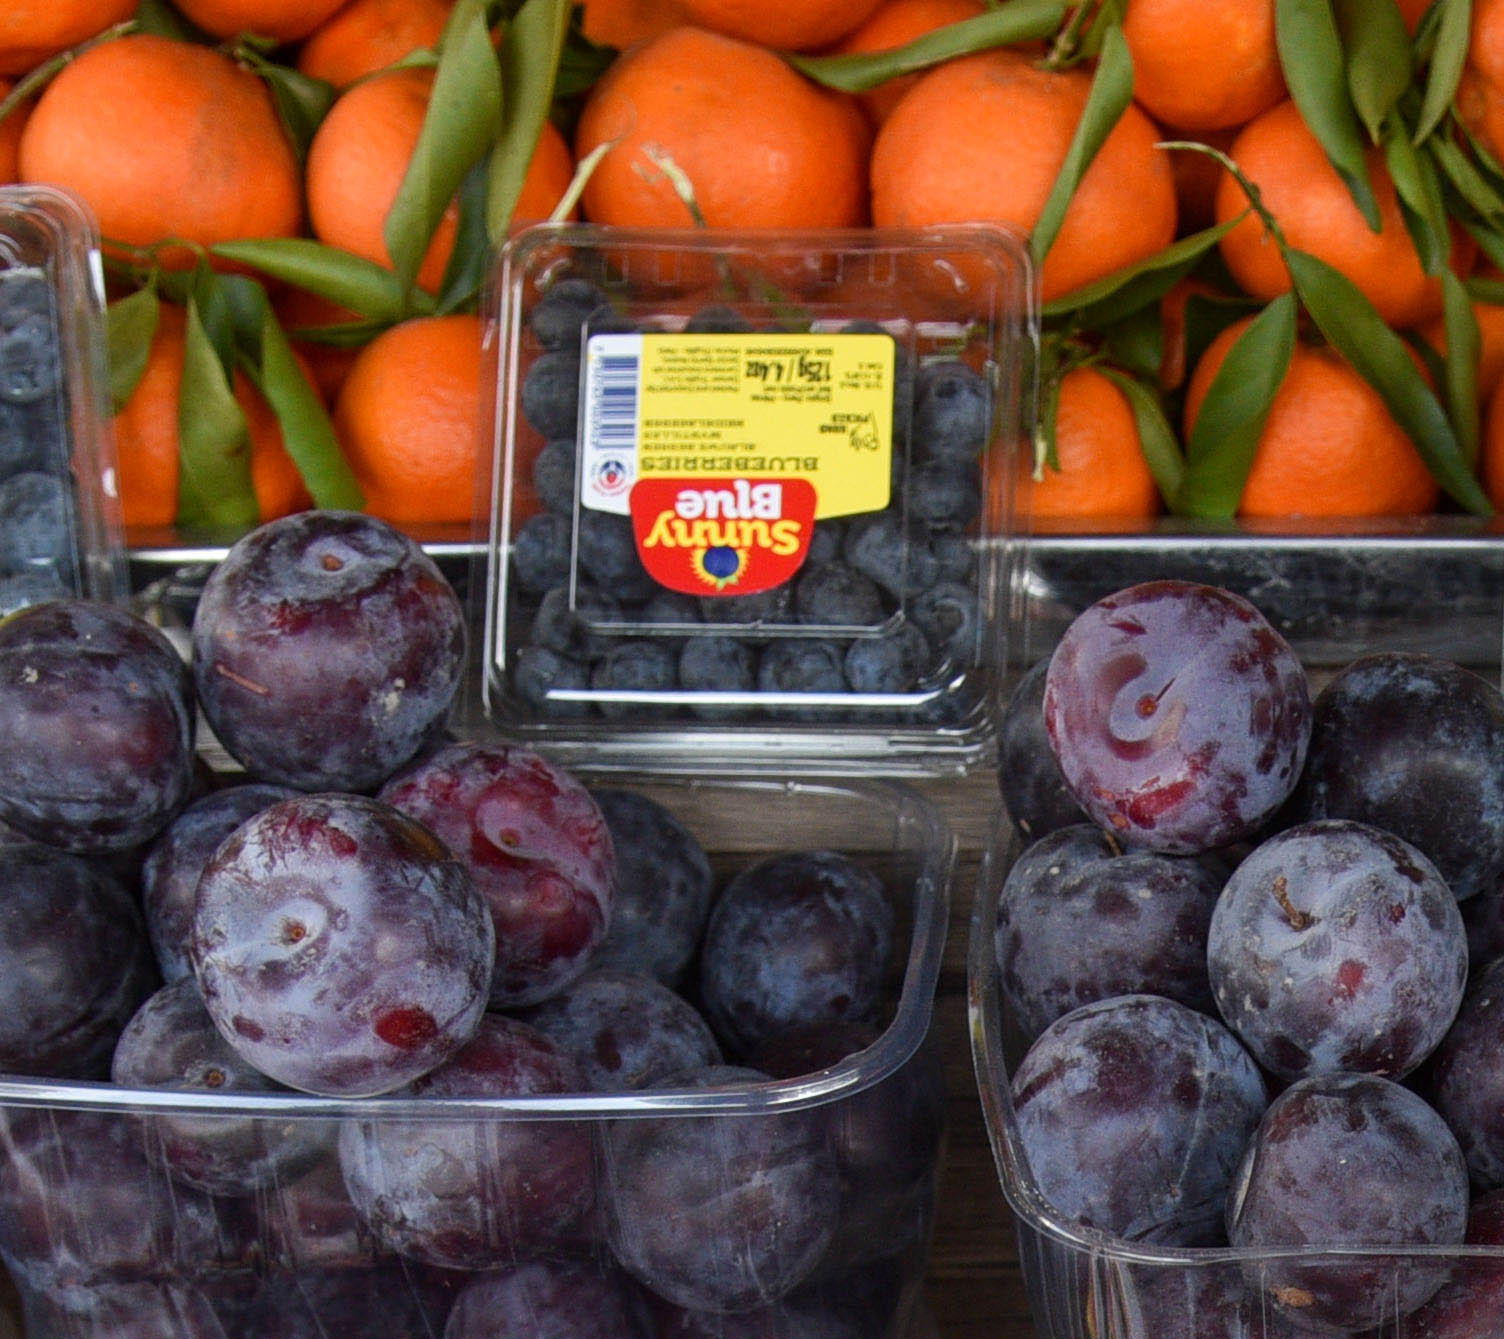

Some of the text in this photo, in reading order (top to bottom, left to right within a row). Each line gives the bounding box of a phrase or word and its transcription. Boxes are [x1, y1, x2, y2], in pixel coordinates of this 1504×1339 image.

[641, 456, 818, 471] BLUEBERRIES
[675, 479, 782, 519] Blue
[643, 510, 801, 555] Sunny
